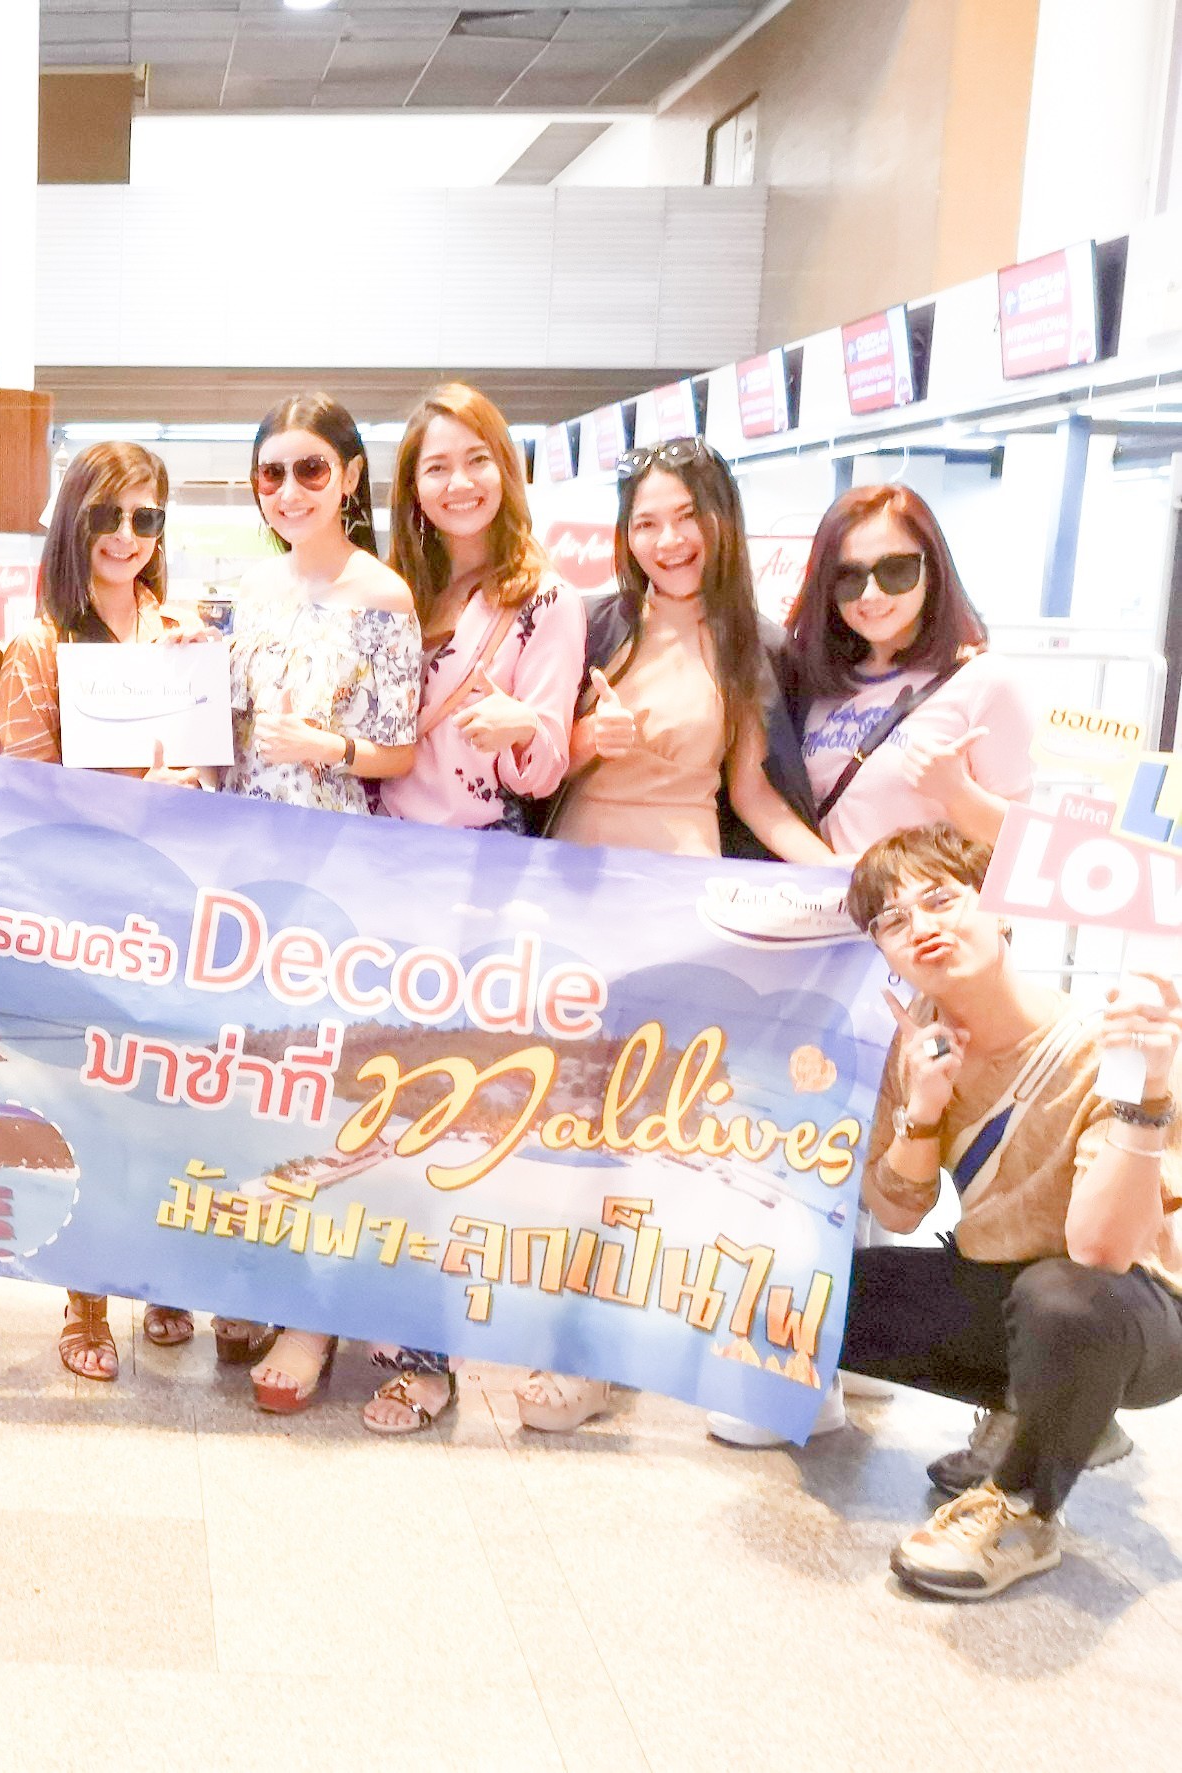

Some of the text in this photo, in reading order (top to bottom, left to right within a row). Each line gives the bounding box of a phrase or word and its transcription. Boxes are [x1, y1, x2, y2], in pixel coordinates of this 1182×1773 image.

[193, 895, 603, 1034] Decode
[86, 1027, 337, 1122] มาซ่าที่
